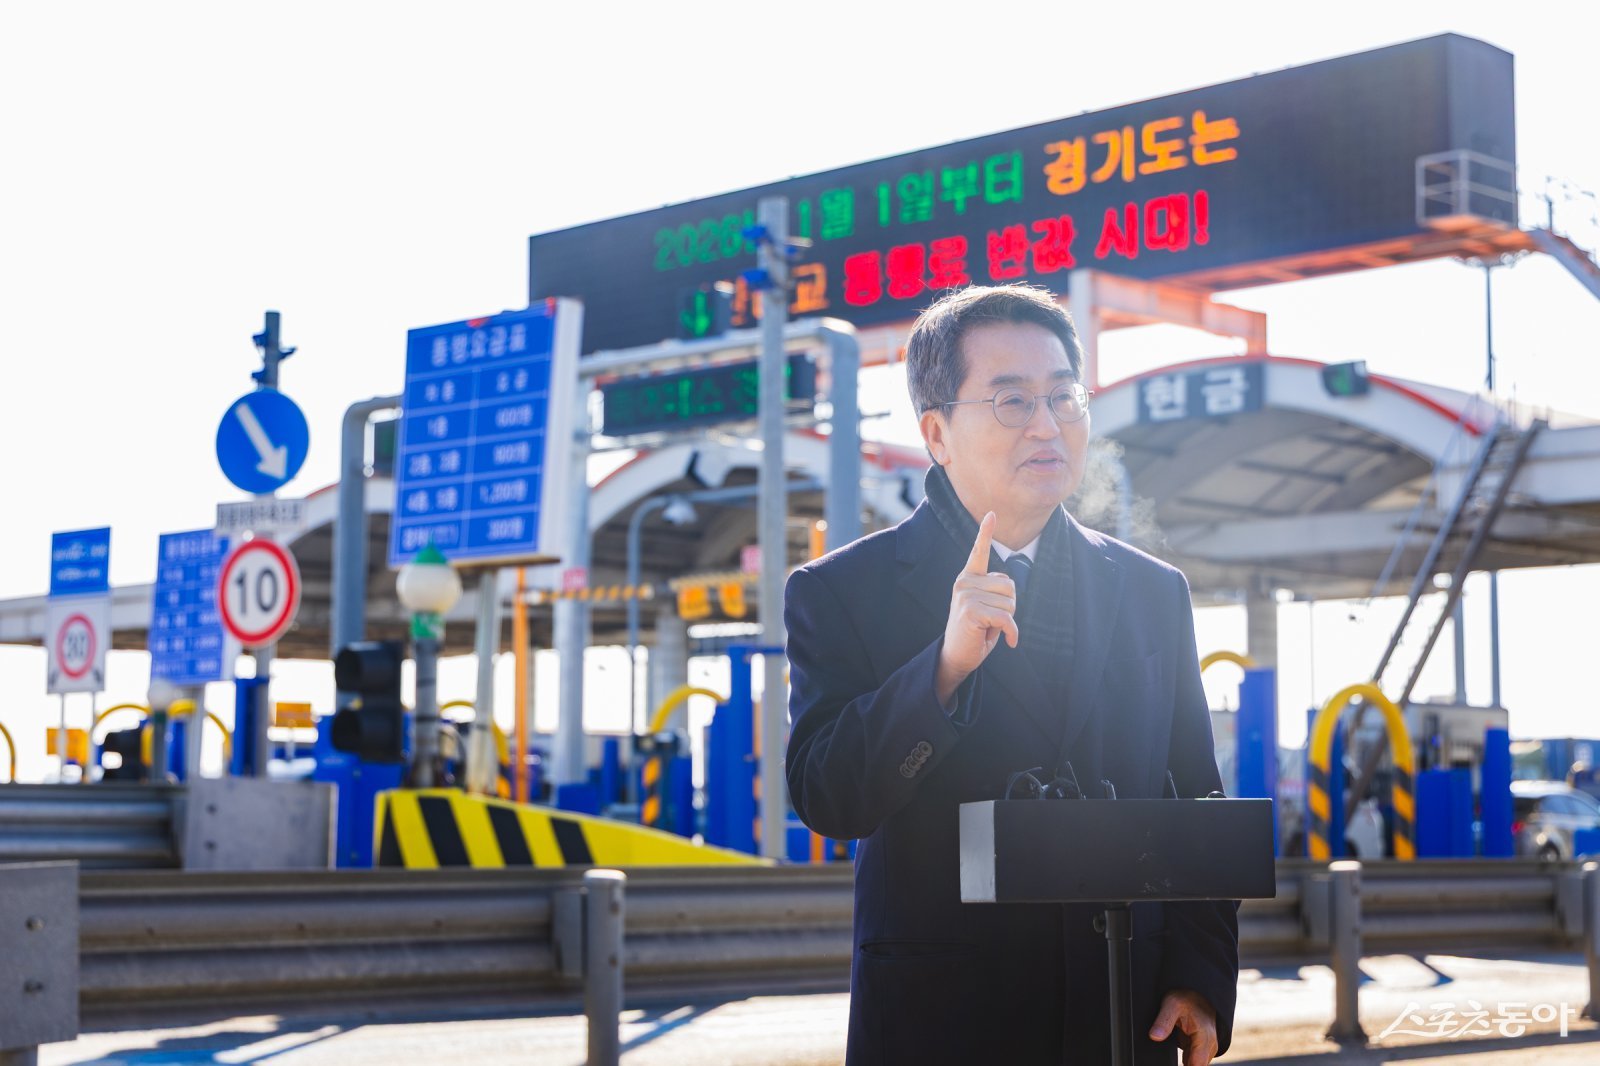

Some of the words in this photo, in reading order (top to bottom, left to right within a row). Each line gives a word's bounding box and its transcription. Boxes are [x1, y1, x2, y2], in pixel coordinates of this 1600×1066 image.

[654, 209, 759, 272] 2026
[1043, 109, 1241, 196] 경기도는
[1093, 188, 1210, 261] 시대!
[234, 567, 279, 617] 10
